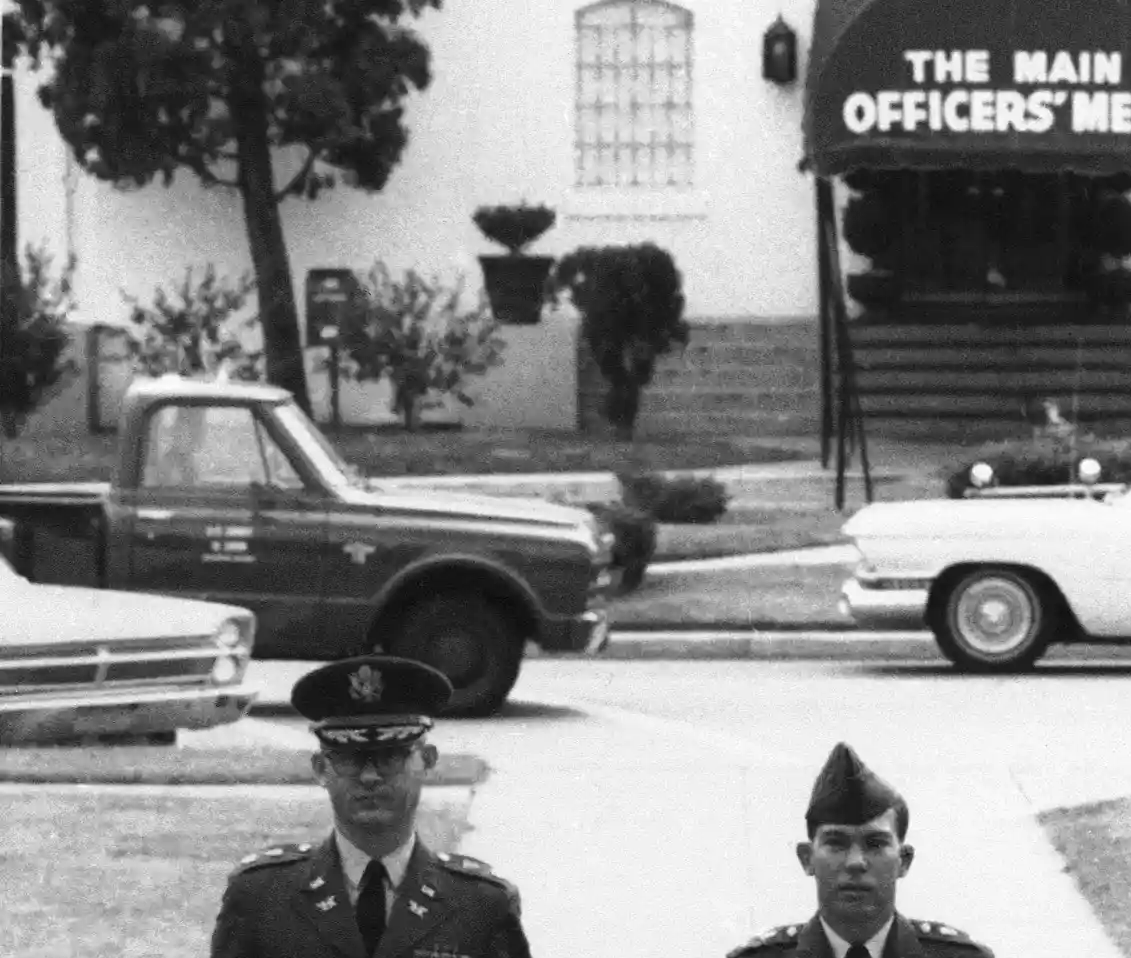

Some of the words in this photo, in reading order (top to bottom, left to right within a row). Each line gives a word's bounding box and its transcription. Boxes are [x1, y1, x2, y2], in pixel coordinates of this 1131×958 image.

[904, 50, 990, 84] THE
[1013, 51, 1122, 84] MAIN
[842, 89, 1068, 134] OFFICERS'
